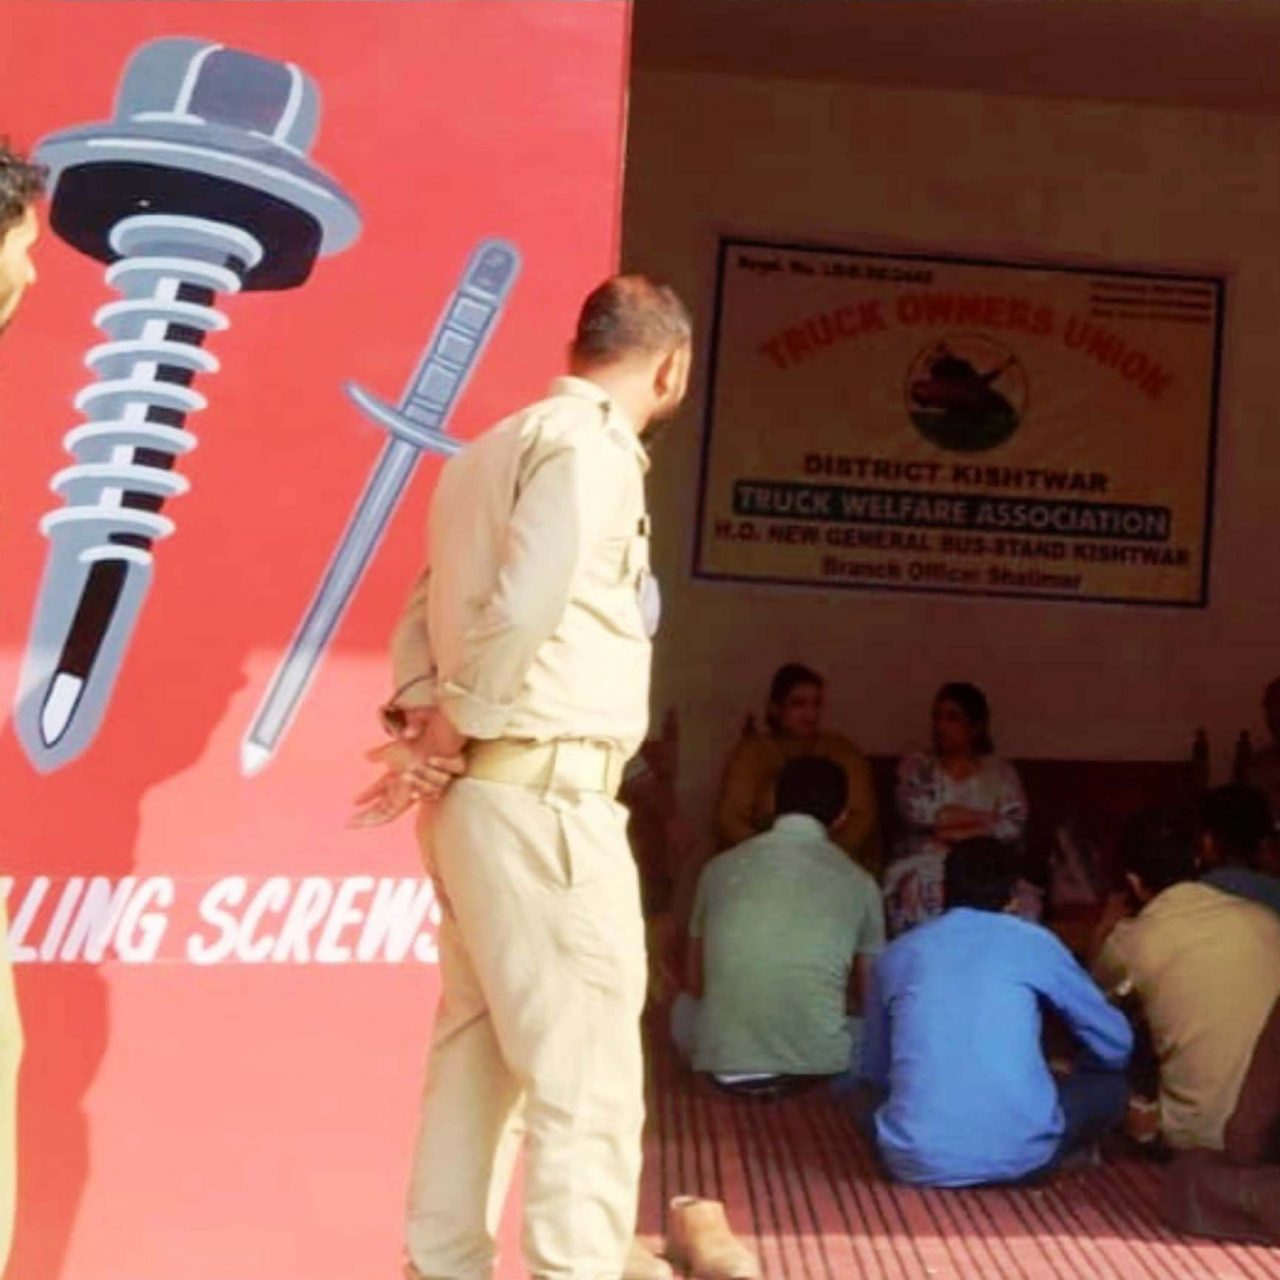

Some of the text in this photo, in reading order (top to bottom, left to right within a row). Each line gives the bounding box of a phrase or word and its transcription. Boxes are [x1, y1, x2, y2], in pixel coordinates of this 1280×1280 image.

[760, 292, 1174, 401] TRUCK OWNERS UNION
[804, 454, 1109, 493] DISTRICT KISHTWAR
[738, 485, 1167, 536] TRUCK WELFARE ASSOCIATION
[769, 527, 819, 547] NEW
[824, 527, 930, 552] GENERAL
[941, 535, 1065, 561] BUS-STAND
[1073, 542, 1190, 567] KISHTWAR
[821, 555, 900, 579] Branch
